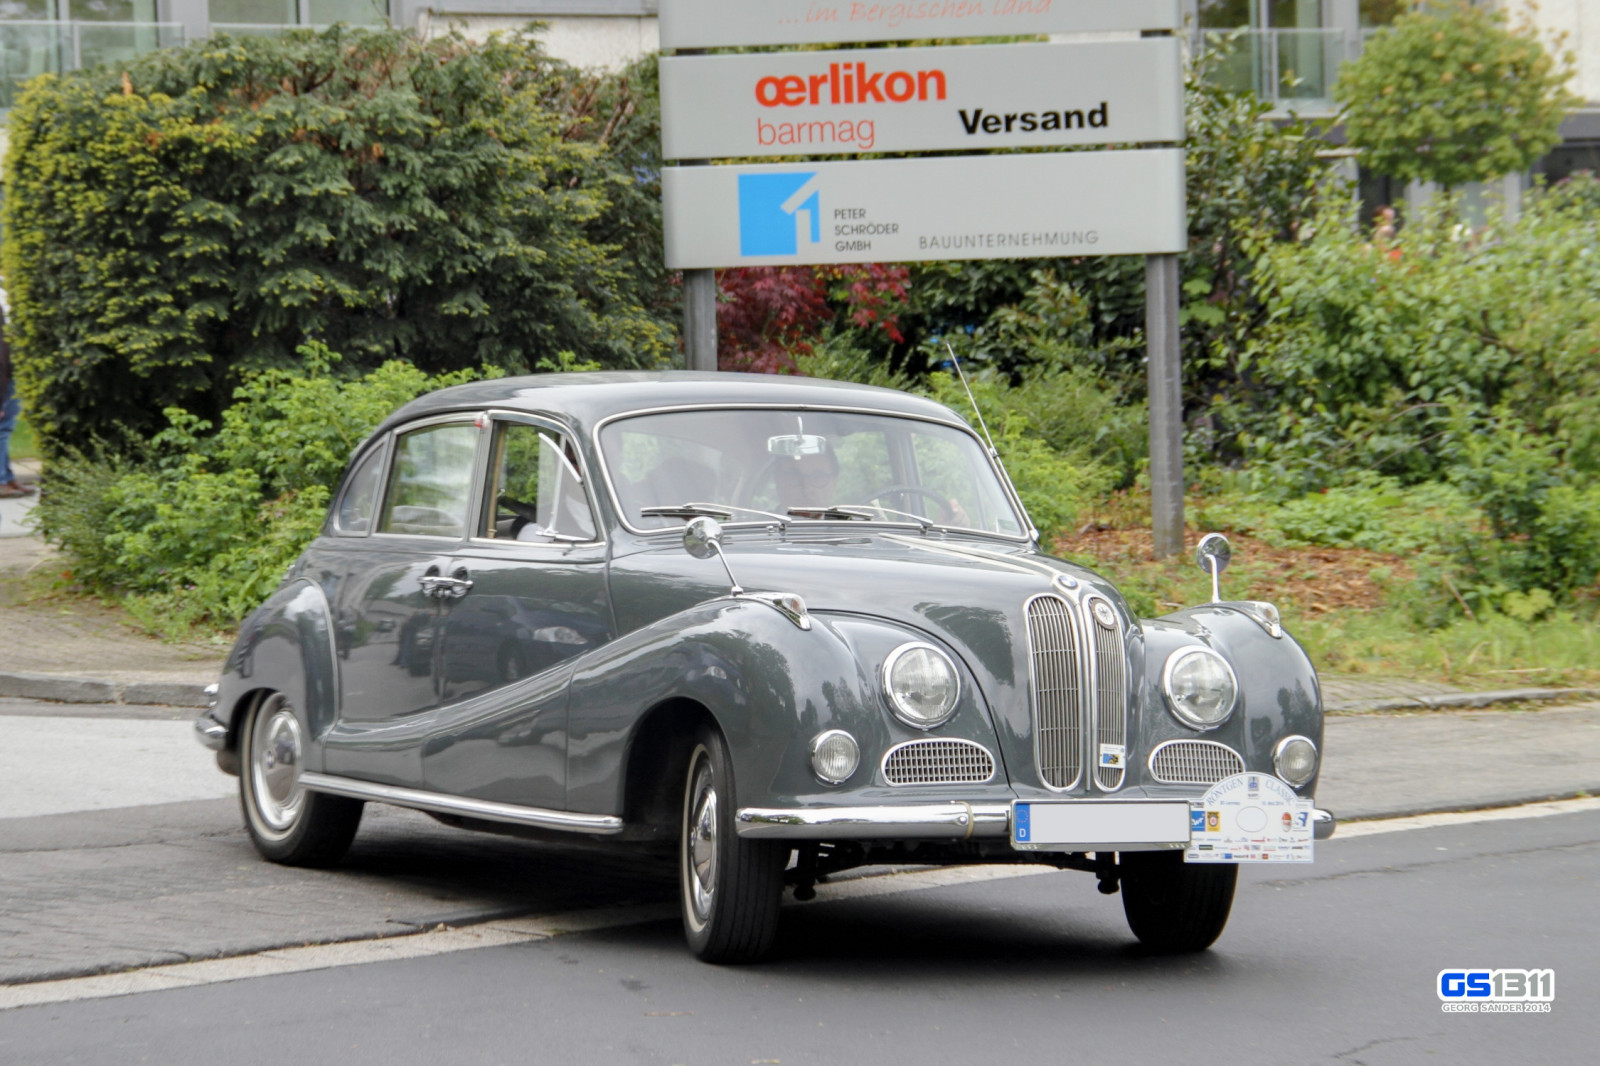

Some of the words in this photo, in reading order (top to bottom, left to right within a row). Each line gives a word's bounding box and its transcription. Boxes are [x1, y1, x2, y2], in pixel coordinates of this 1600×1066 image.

[958, 101, 1109, 135] Versand
[757, 117, 875, 149] barmag
[834, 208, 867, 220] PETER
[834, 221, 899, 236] SCHRÖDER
[835, 240, 872, 252] GMBH
[918, 230, 1099, 250] BAUUNTERNEHMUNG
[1019, 828, 1027, 838] D
